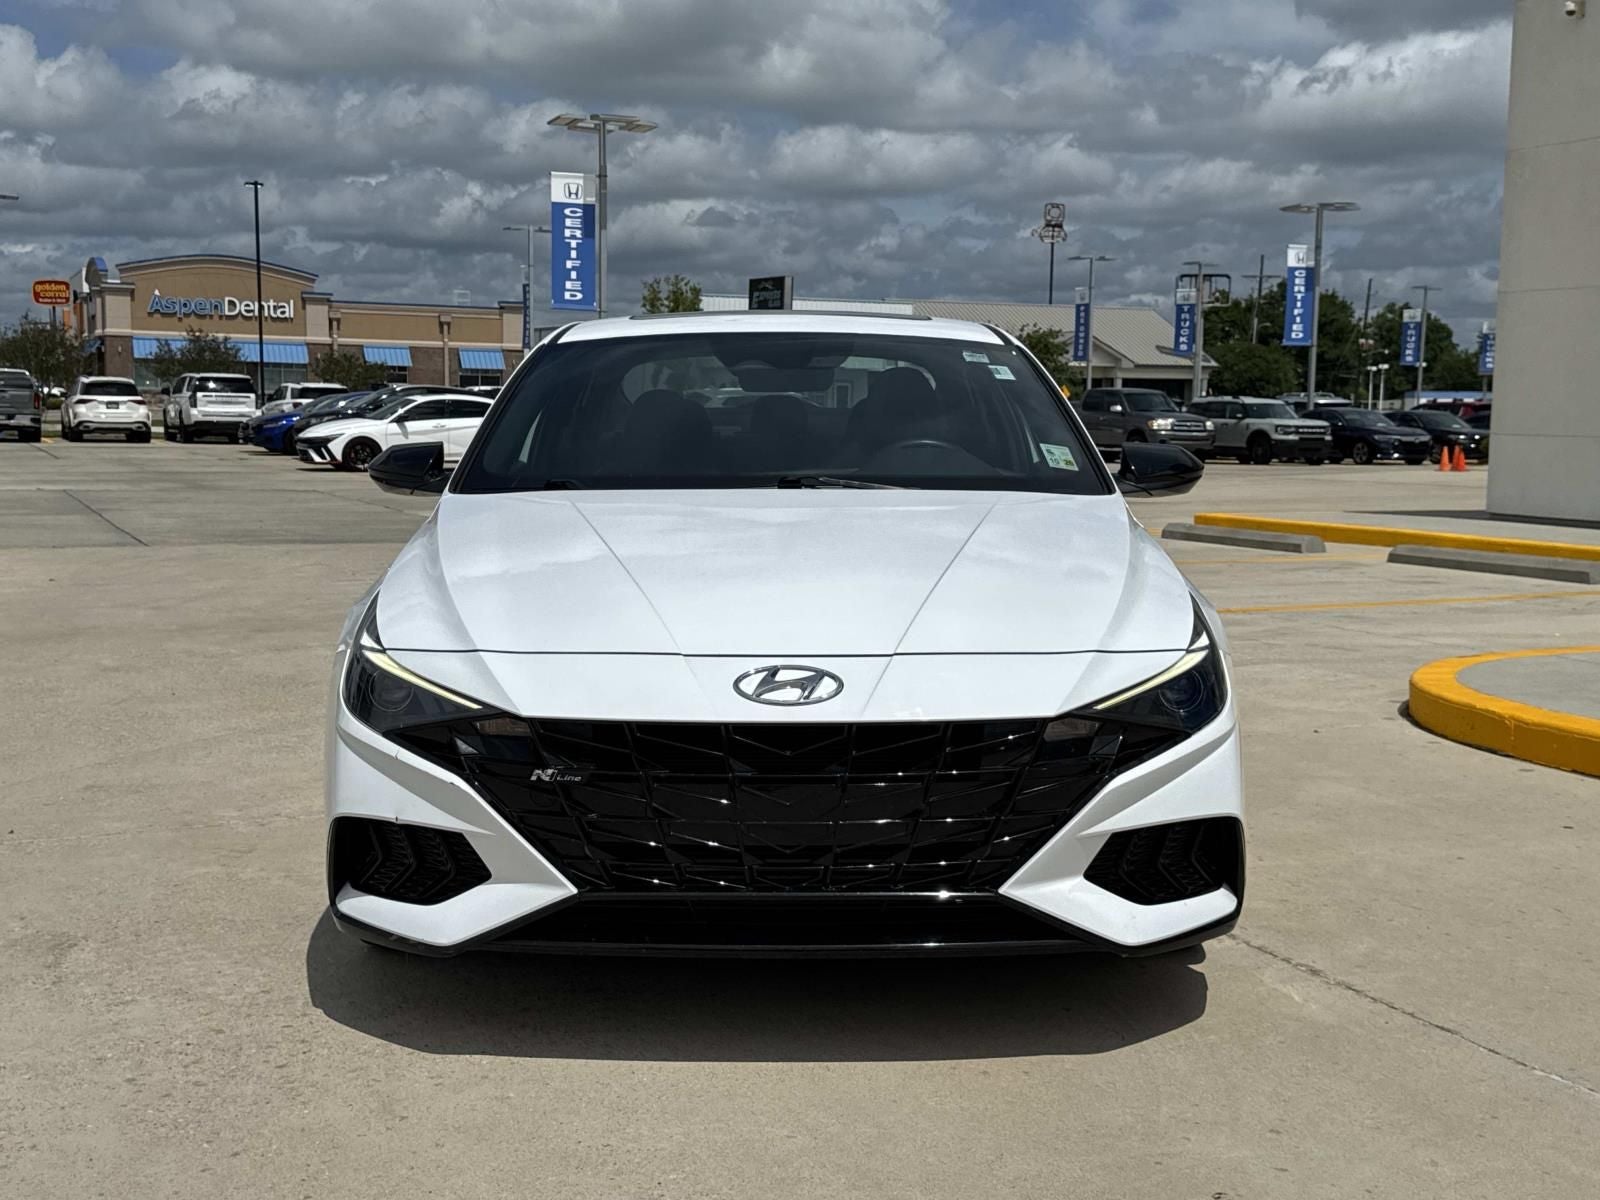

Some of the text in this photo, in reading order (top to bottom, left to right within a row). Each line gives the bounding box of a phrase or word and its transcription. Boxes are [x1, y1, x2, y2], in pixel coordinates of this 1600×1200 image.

[563, 207, 583, 300] CERTIFIED
[1179, 305, 1190, 351] TRUCKS
[1291, 269, 1306, 338] CERTIFIED
